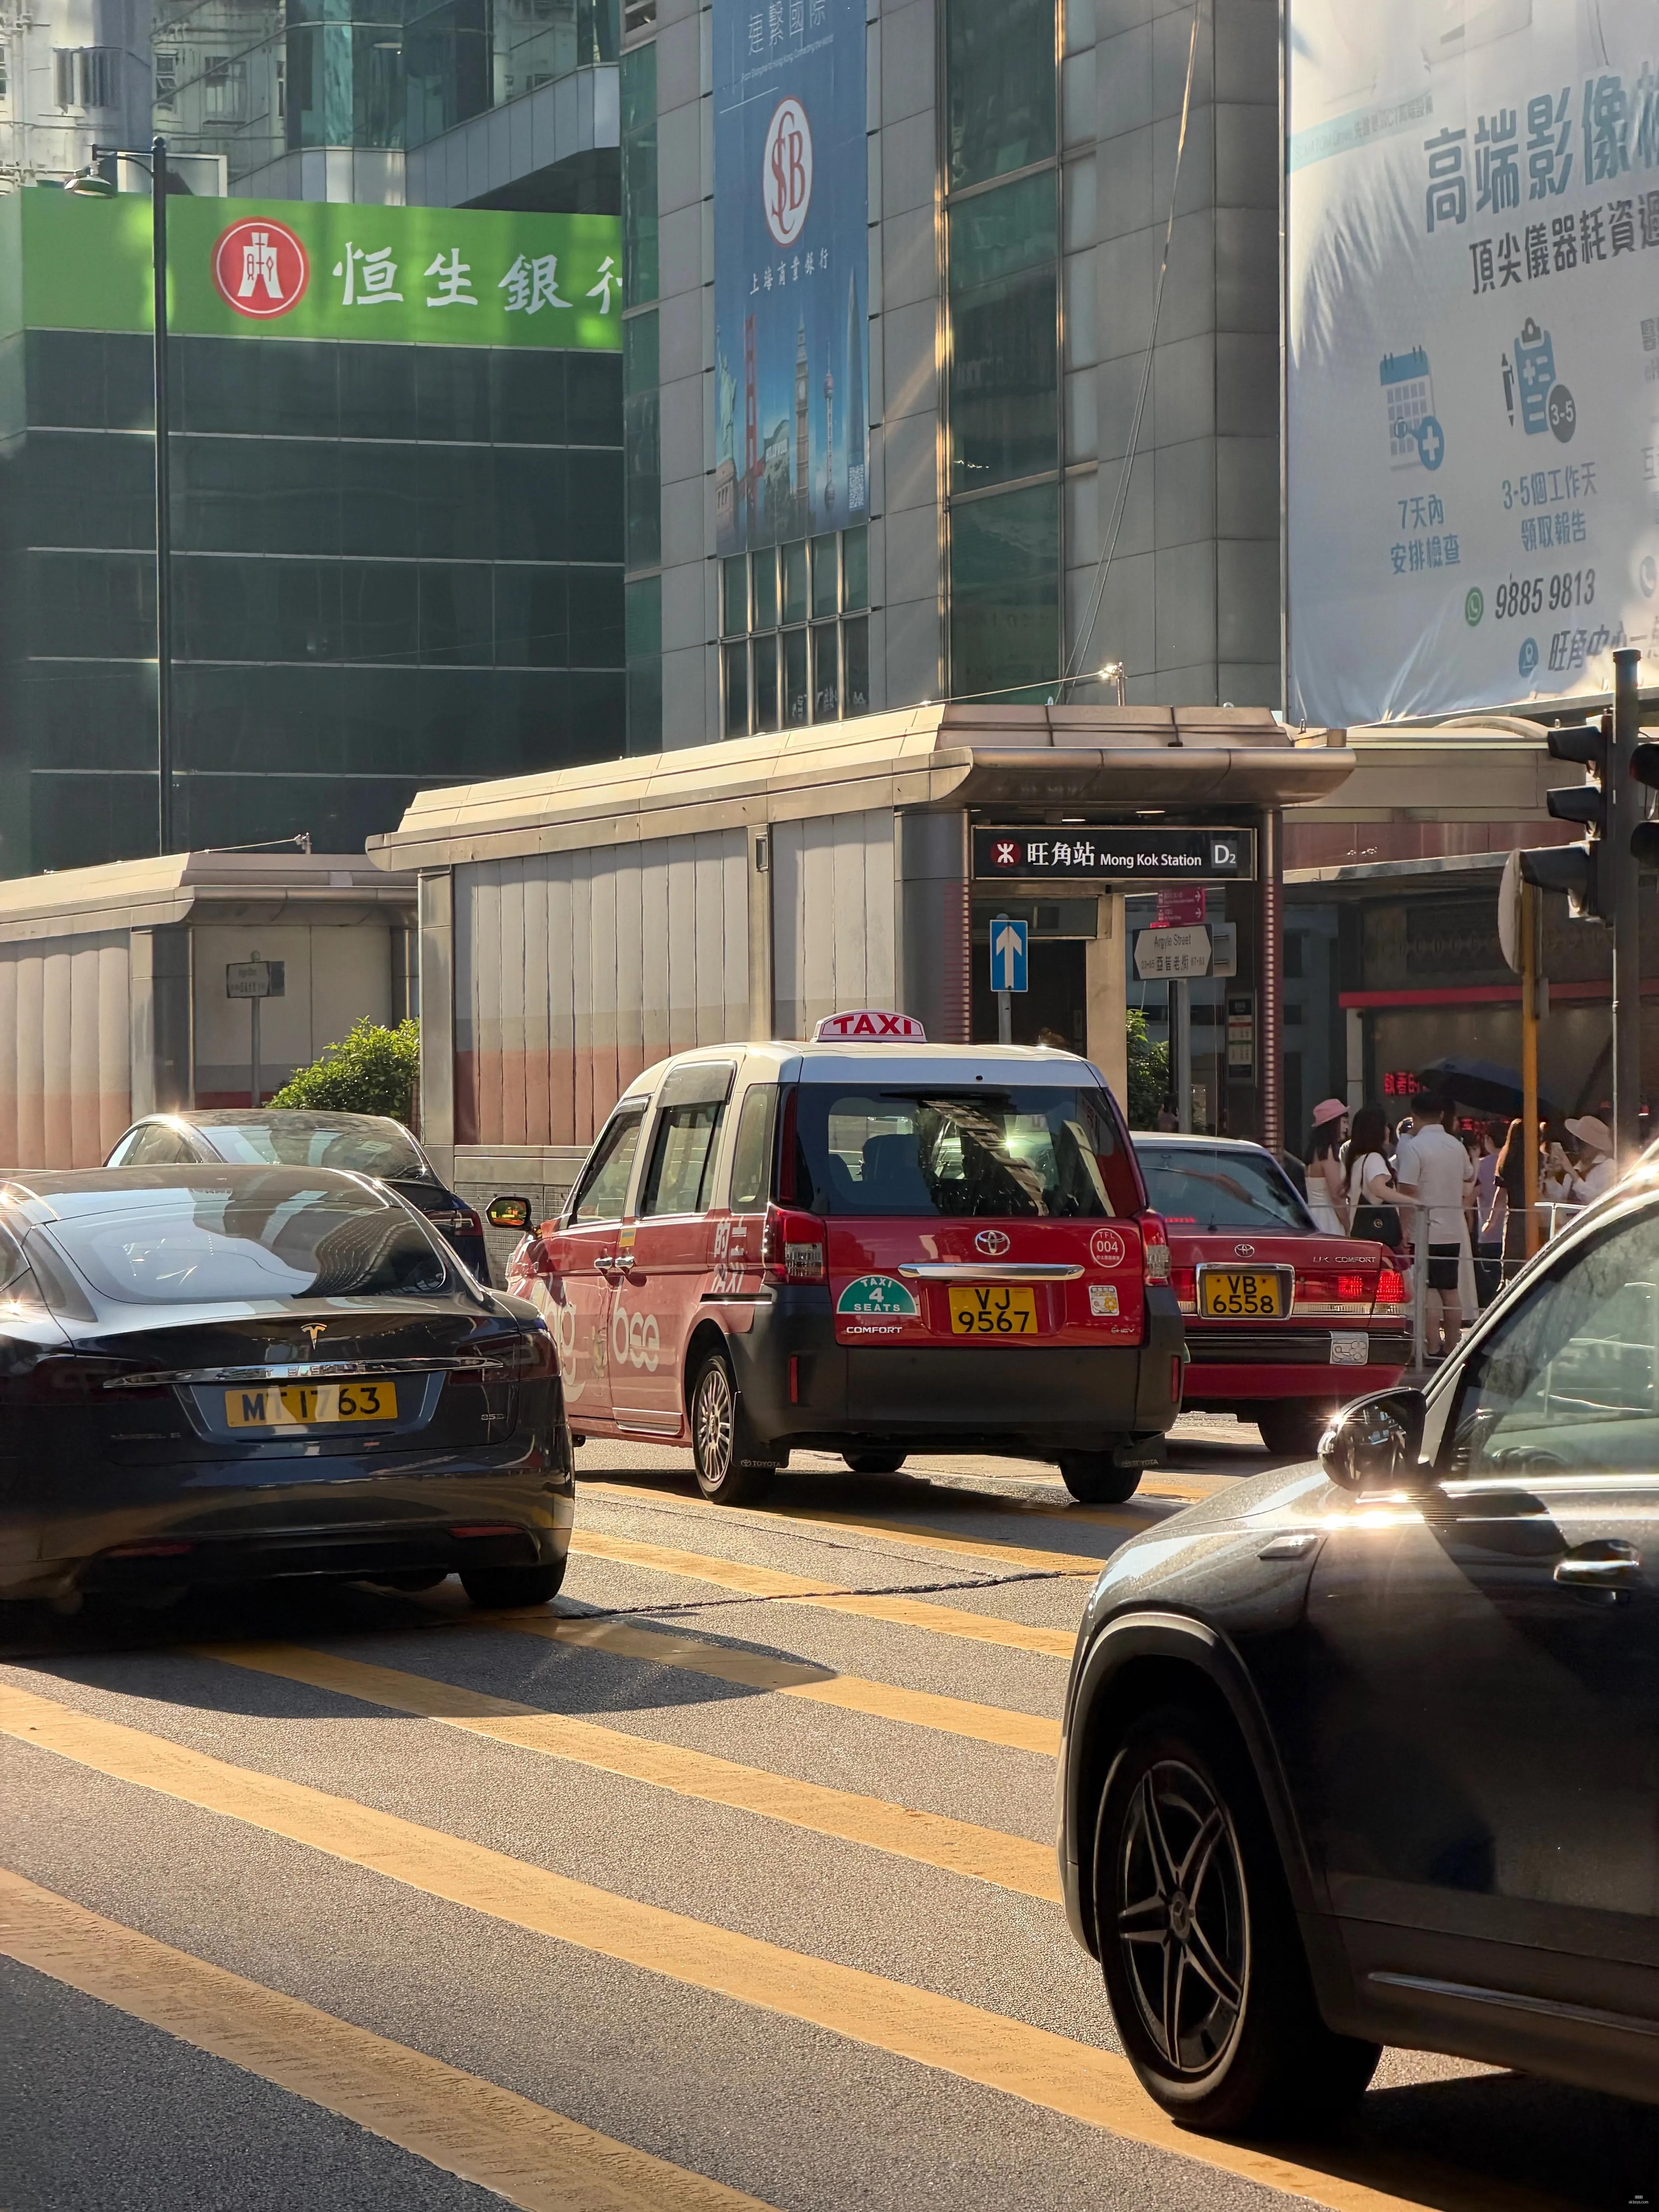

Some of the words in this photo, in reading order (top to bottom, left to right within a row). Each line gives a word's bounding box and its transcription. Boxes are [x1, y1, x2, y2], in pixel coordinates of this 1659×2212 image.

[1551, 400, 1574, 425] 3-5
[1502, 462, 1598, 510] 3-5個工作天
[1521, 508, 1586, 551] 領取報告
[1391, 533, 1461, 575] 安排檢查
[1495, 578, 1544, 619] 9885
[1549, 568, 1595, 610] 9813
[1027, 842, 1095, 866] 旺角站
[1100, 854, 1134, 869] Mong
[1137, 853, 1159, 866] Kok
[1161, 854, 1202, 866] Station
[1214, 845, 1236, 864] D2
[1154, 935, 1172, 951] Argyle
[1173, 934, 1191, 946] Street
[1156, 954, 1188, 971] 亞皆老街
[833, 1014, 912, 1034] TAXI
[1097, 1240, 1118, 1252] 004
[860, 1278, 892, 1288] TAXI
[1227, 1276, 1257, 1294] VB
[869, 1288, 884, 1302] 4
[974, 1288, 1010, 1310] VJ
[1213, 1295, 1274, 1314] 6558
[854, 1303, 900, 1312] SEATS
[613, 1276, 659, 1372] bee
[958, 1311, 1030, 1332] 9567
[300, 1387, 380, 1419] 1763
